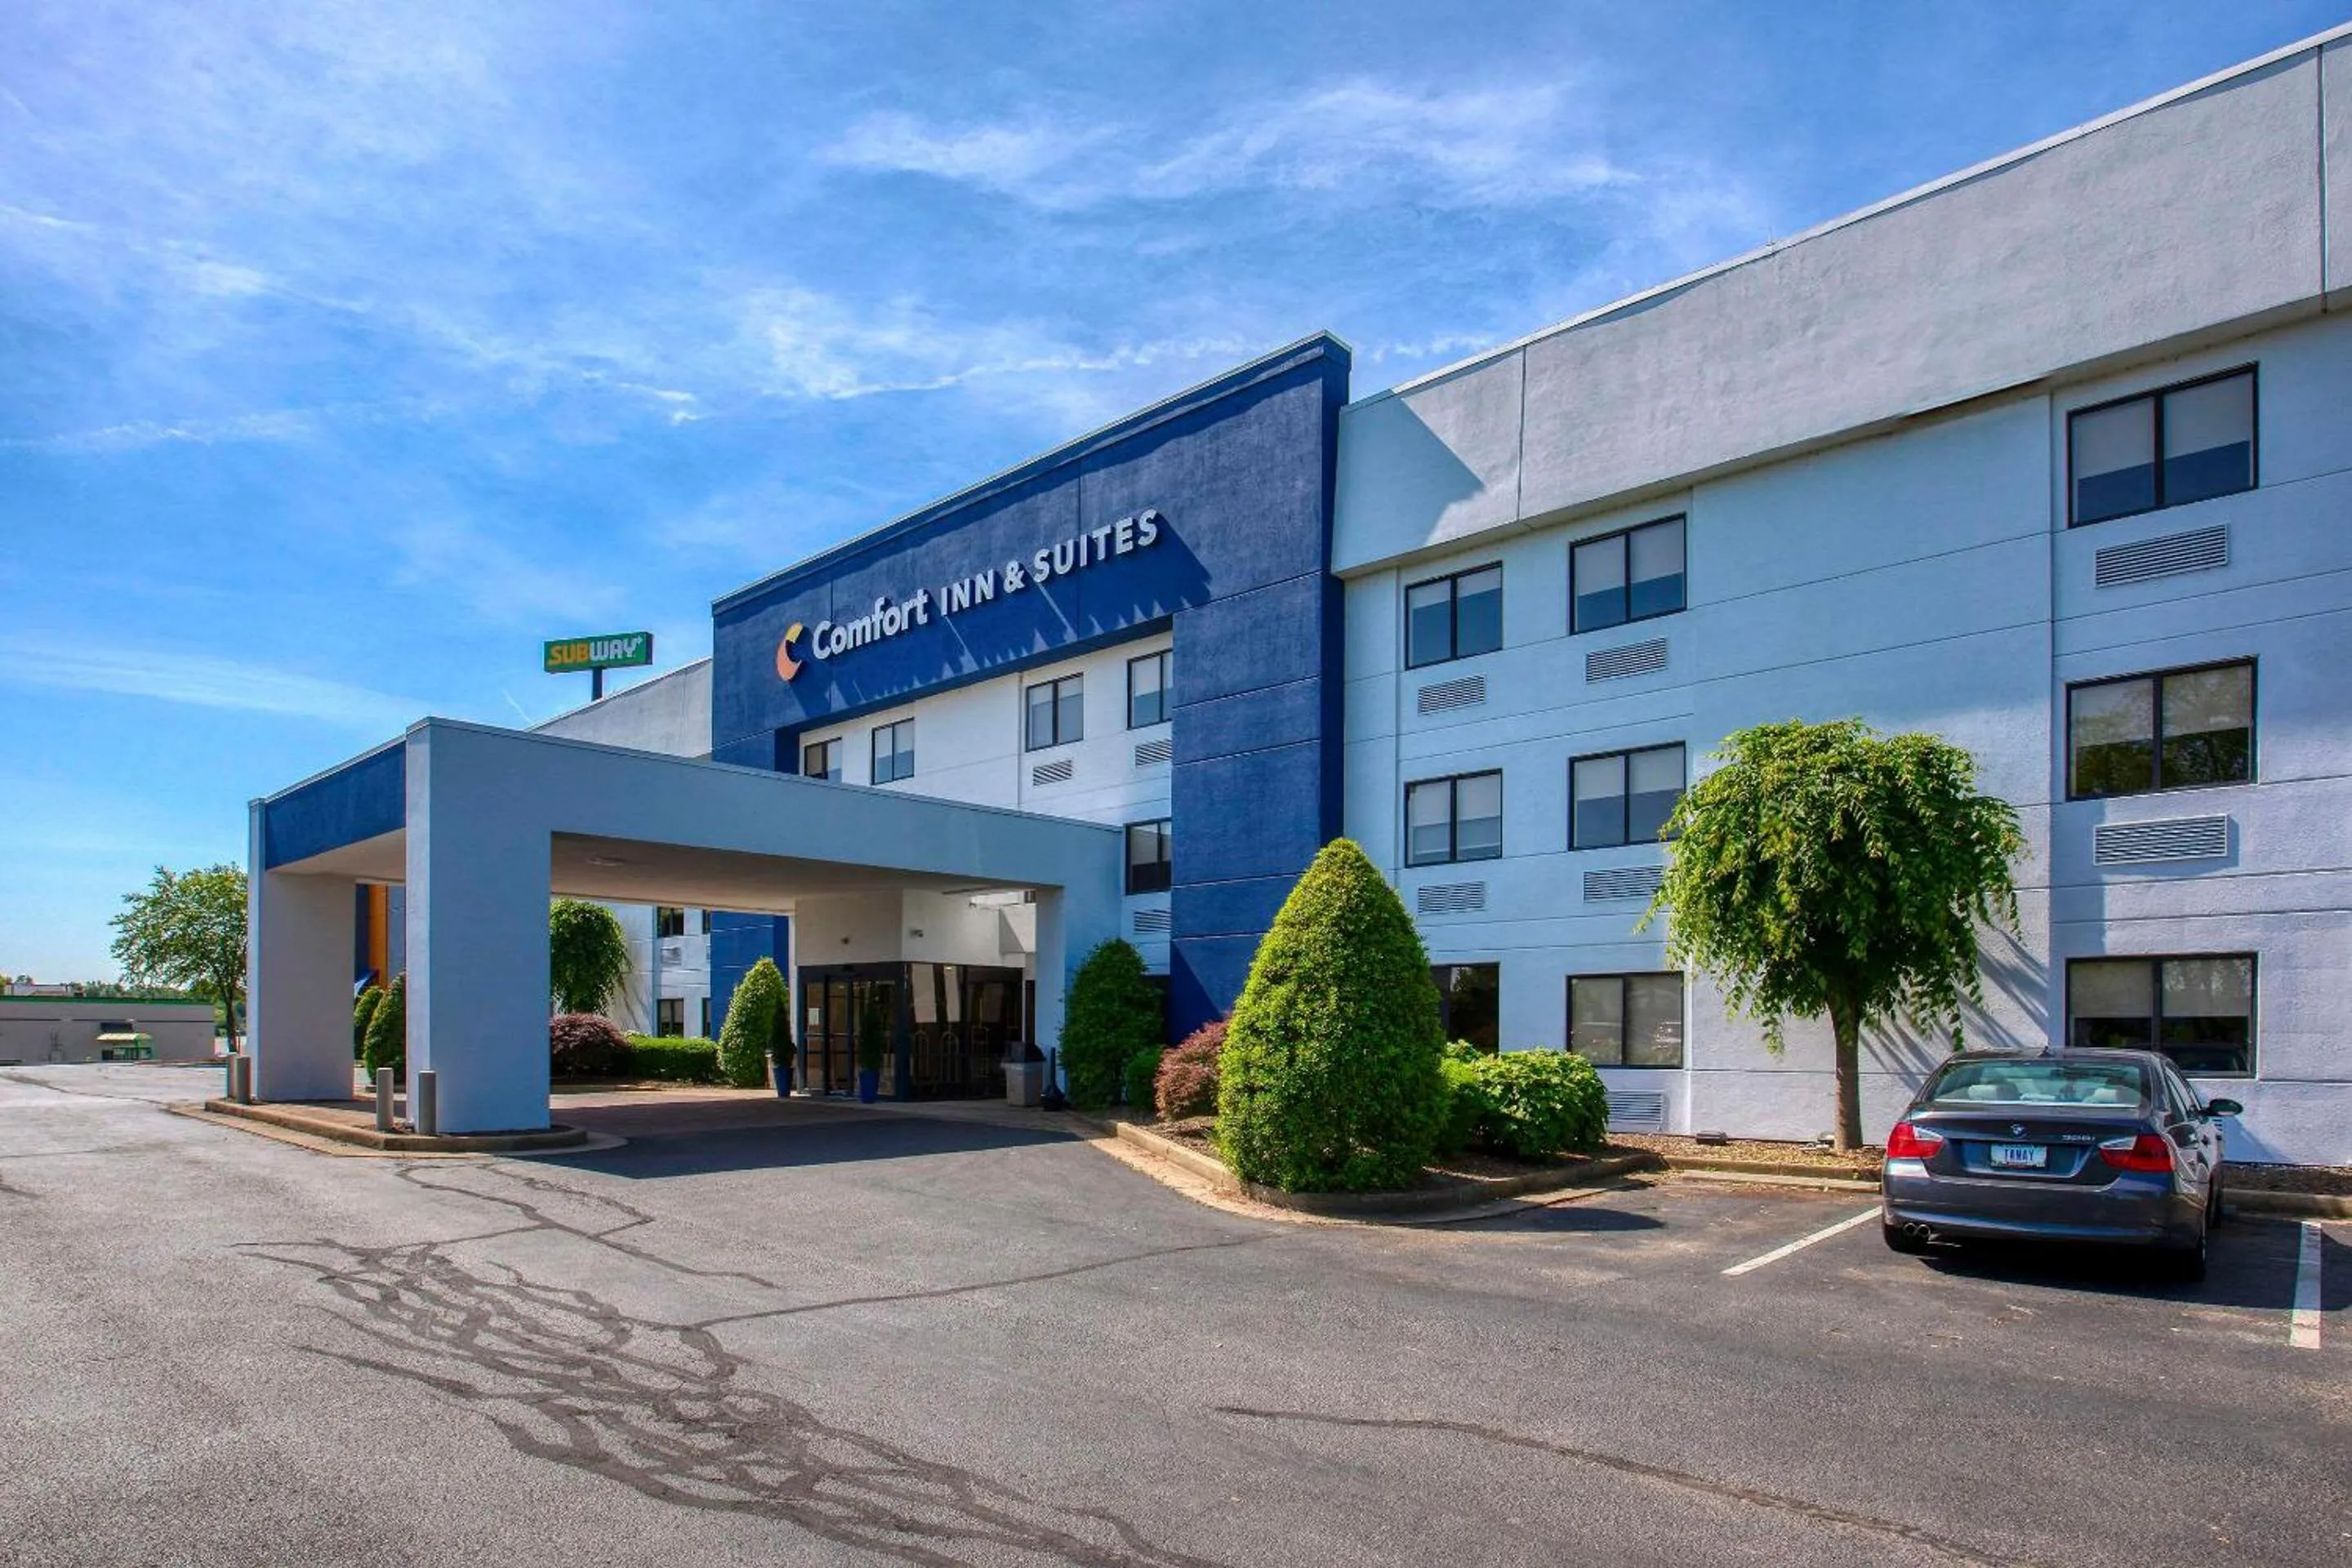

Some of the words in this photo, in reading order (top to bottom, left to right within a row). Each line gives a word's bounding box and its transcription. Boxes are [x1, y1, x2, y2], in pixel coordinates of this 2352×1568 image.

[813, 589, 928, 659] Comfort
[940, 569, 995, 616] INN
[1004, 560, 1025, 594] &
[1033, 509, 1158, 582] SUITES
[547, 636, 642, 666] SUBWAY
